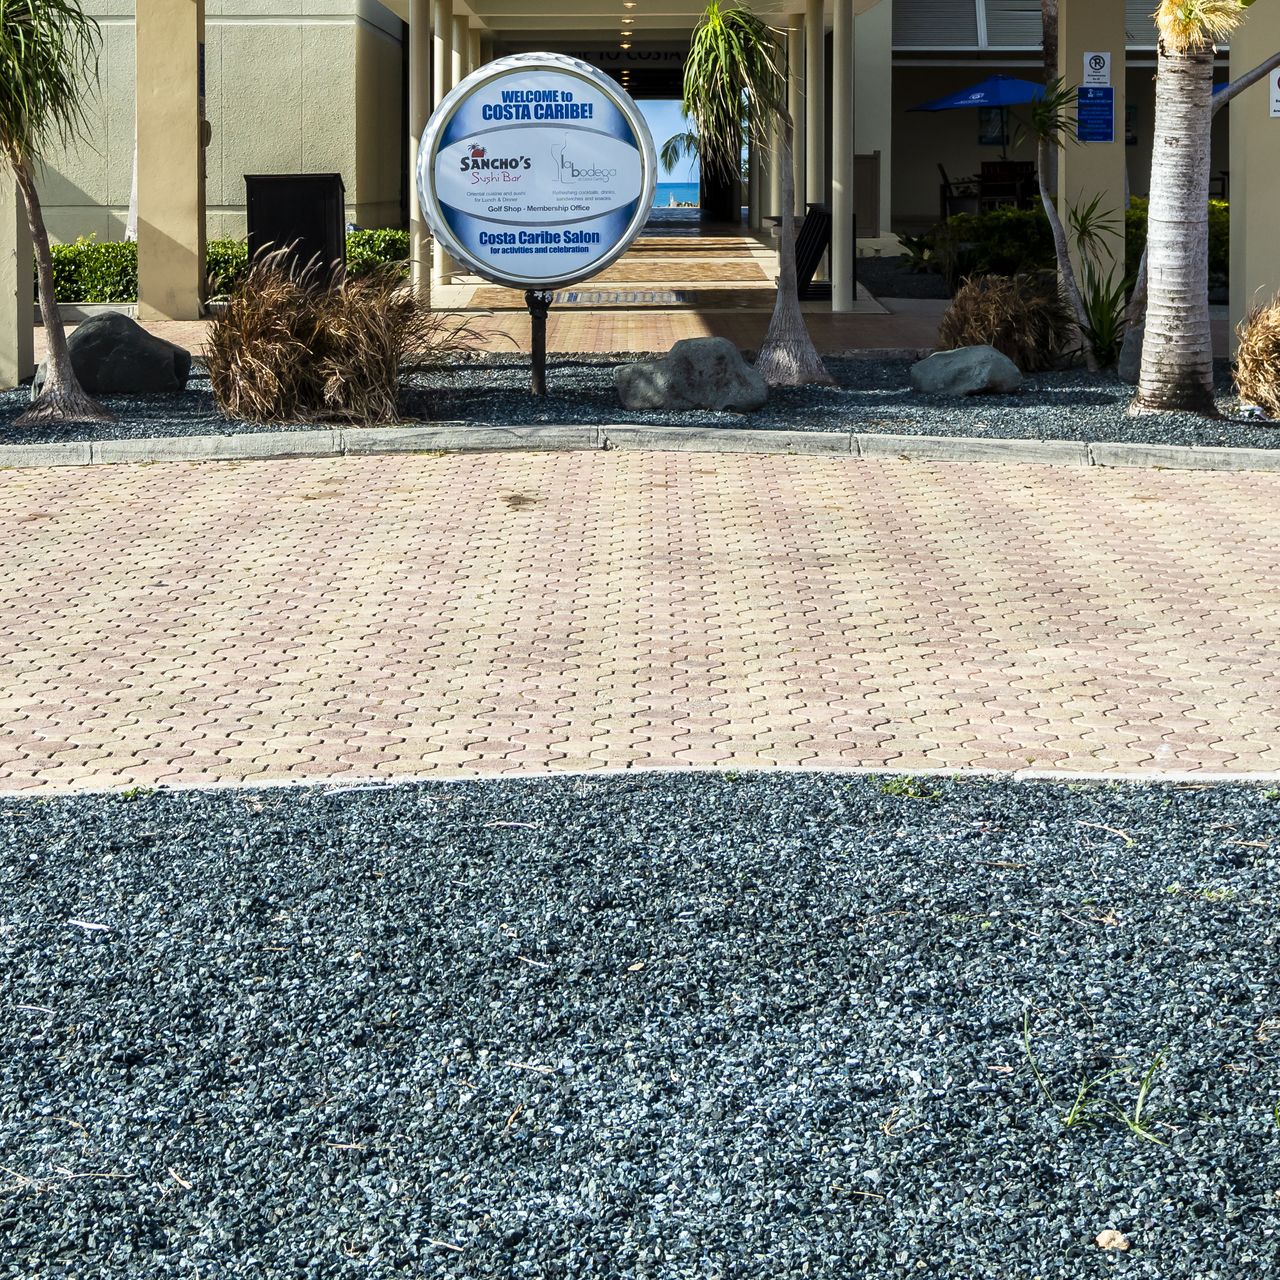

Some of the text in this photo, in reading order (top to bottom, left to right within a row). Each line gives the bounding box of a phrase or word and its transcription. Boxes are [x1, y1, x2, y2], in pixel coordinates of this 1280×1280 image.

[501, 90, 573, 103] WELCOME to
[482, 103, 593, 120] COSTA CARIBE!
[460, 156, 531, 172] SANCHO'S
[561, 154, 571, 169] la
[471, 171, 521, 185] Sushi Bar
[572, 160, 616, 183] bodega
[503, 205, 522, 213] Shop
[479, 230, 600, 245] Costa Caribe Salon
[501, 246, 533, 254] activities
[534, 246, 548, 254] and
[549, 245, 589, 253] celebration
